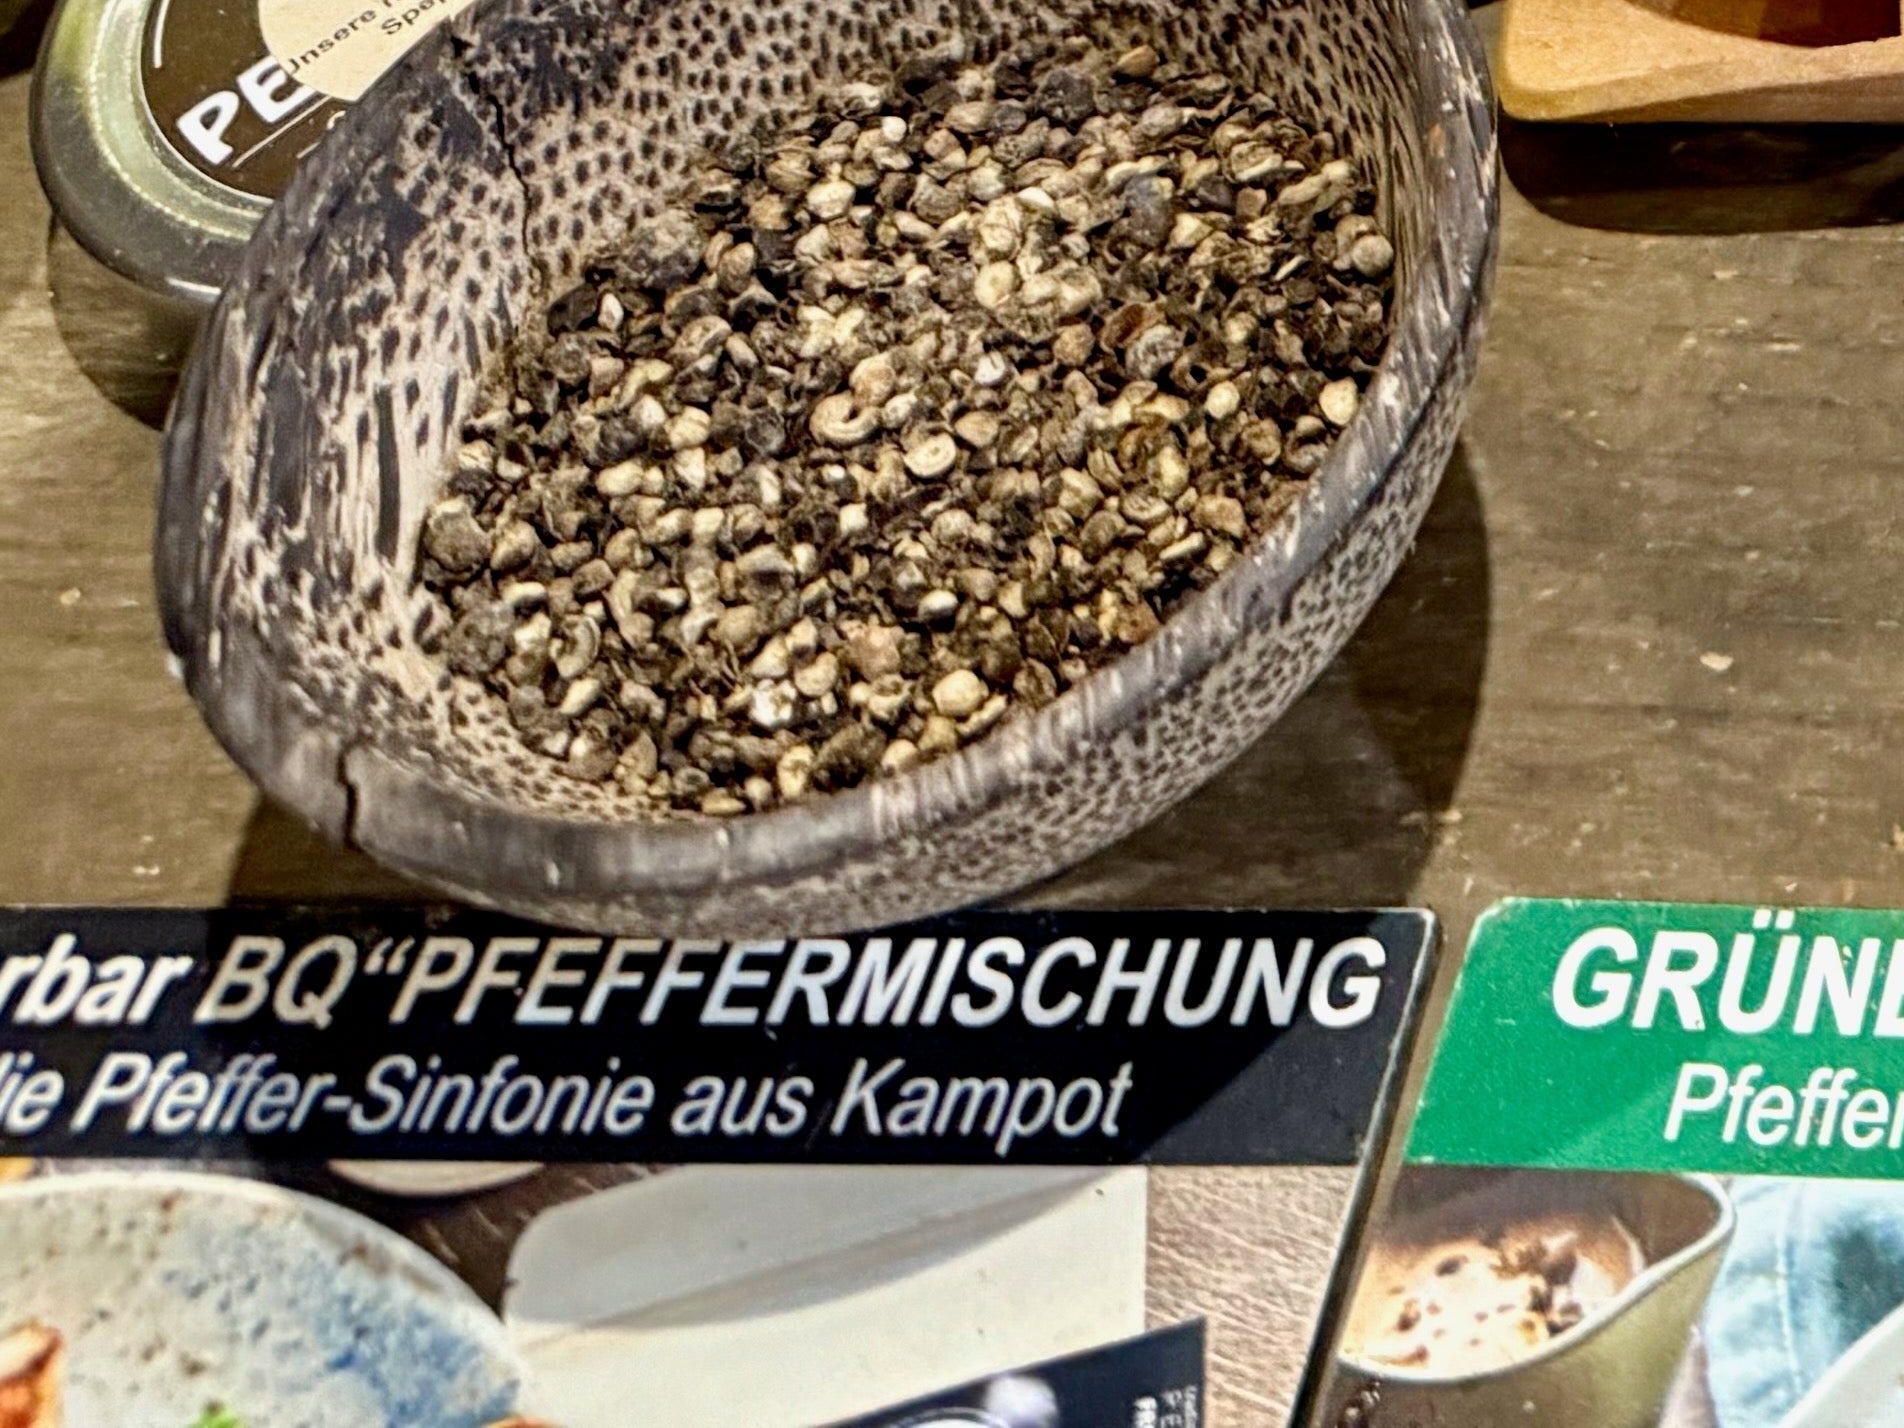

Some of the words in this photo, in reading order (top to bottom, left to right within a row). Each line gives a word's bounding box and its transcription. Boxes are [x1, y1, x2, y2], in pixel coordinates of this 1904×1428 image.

[68, 1050, 658, 1135] Pfeffer-Sinfonie
[671, 1075, 815, 1137] aus
[828, 1056, 1135, 1160] Kampot
